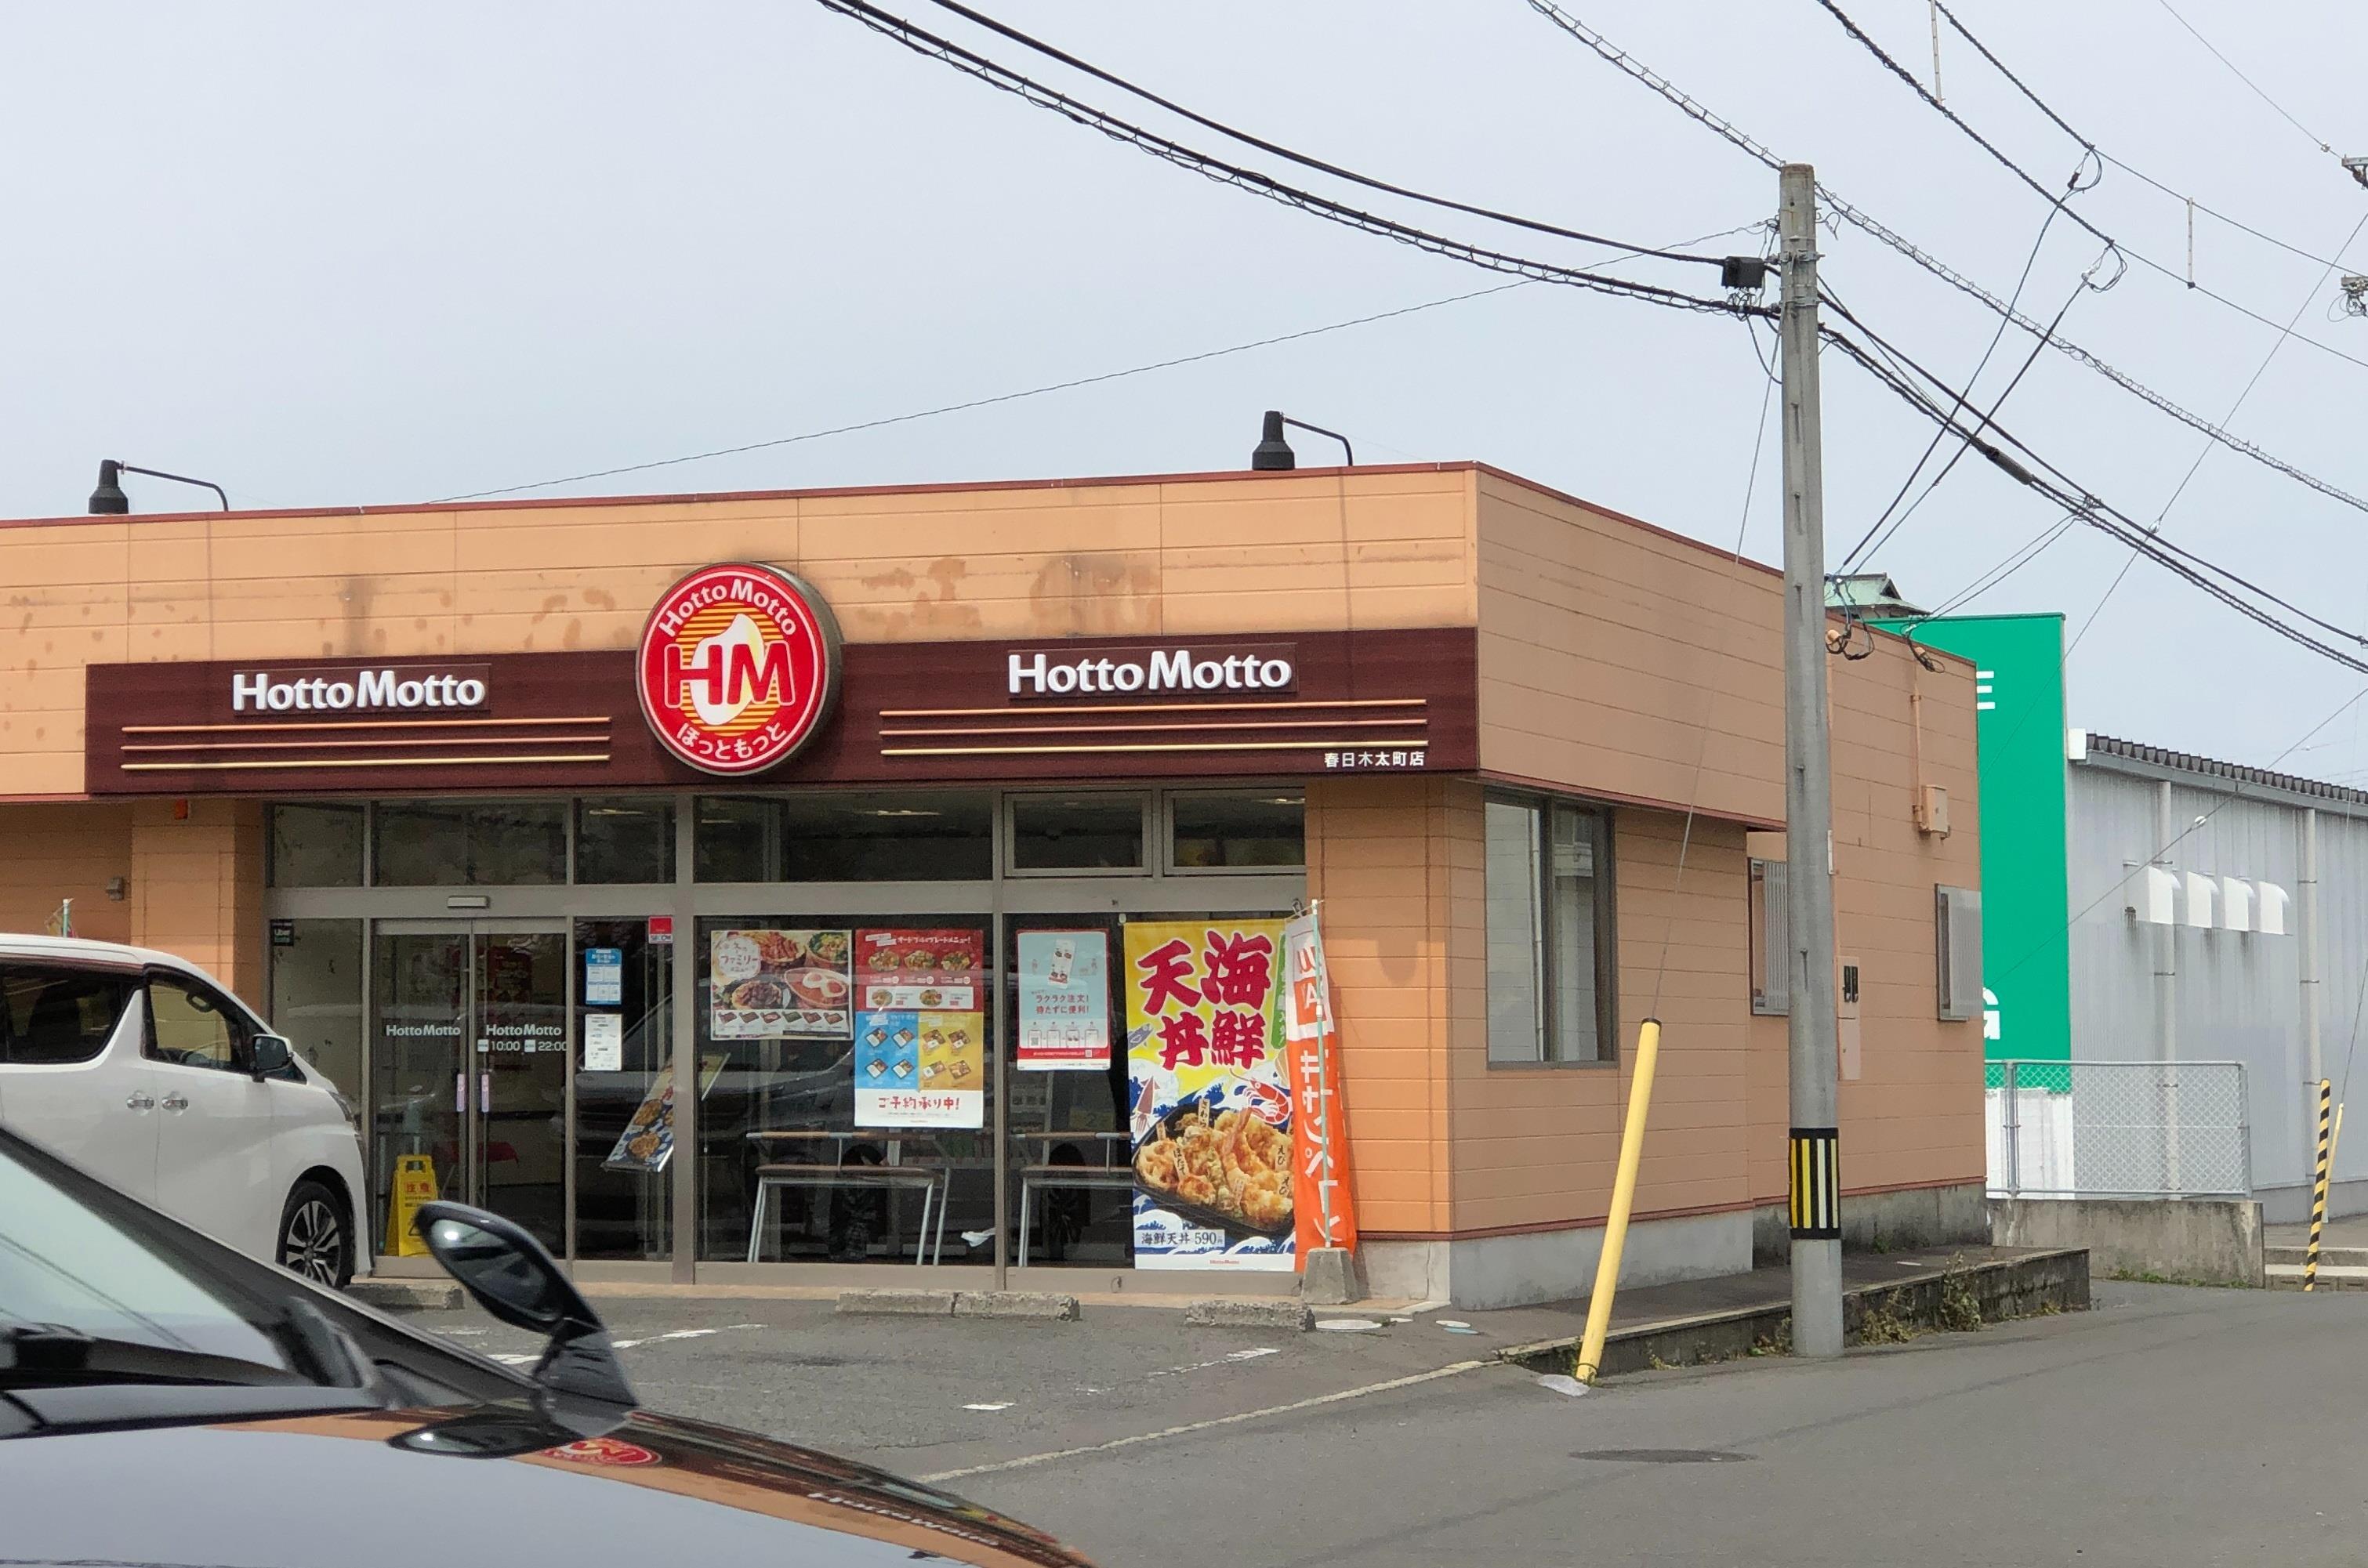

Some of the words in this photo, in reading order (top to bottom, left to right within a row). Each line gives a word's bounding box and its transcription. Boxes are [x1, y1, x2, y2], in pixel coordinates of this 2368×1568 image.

[676, 721, 787, 761] ほっともっと
[1324, 751, 1425, 767] 春日木太町店
[491, 1041, 520, 1052] 10:00
[538, 1041, 567, 1052] 22:00
